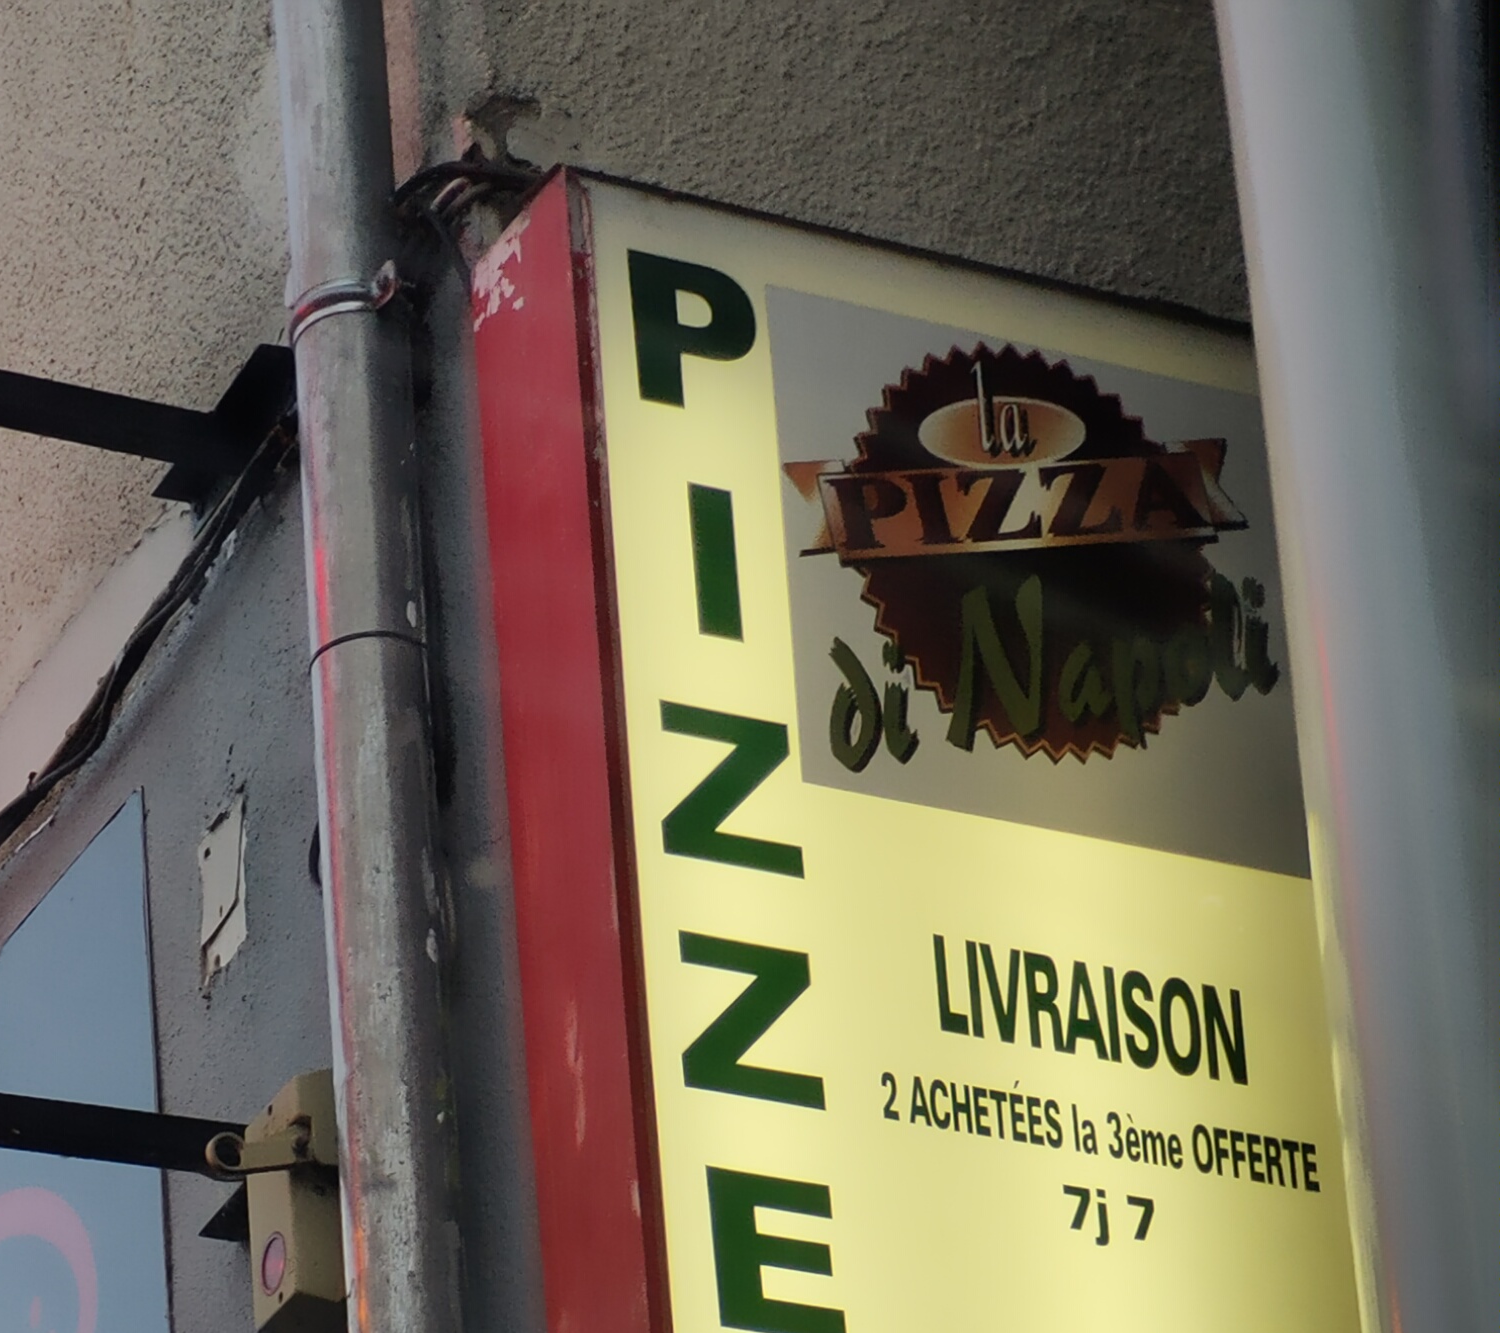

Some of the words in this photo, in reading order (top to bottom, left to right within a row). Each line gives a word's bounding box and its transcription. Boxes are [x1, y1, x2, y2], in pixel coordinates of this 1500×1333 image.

[828, 459, 1216, 550] PIZZA
[946, 573, 1280, 753] Napoli
[933, 933, 1248, 1086] LIVRAISON
[881, 1071, 900, 1121] 2
[910, 1080, 1064, 1149] ACHETÉES
[1071, 1103, 1099, 1156] la
[1108, 1110, 1183, 1170] 3ème
[1192, 1124, 1321, 1193] OFFERTE
